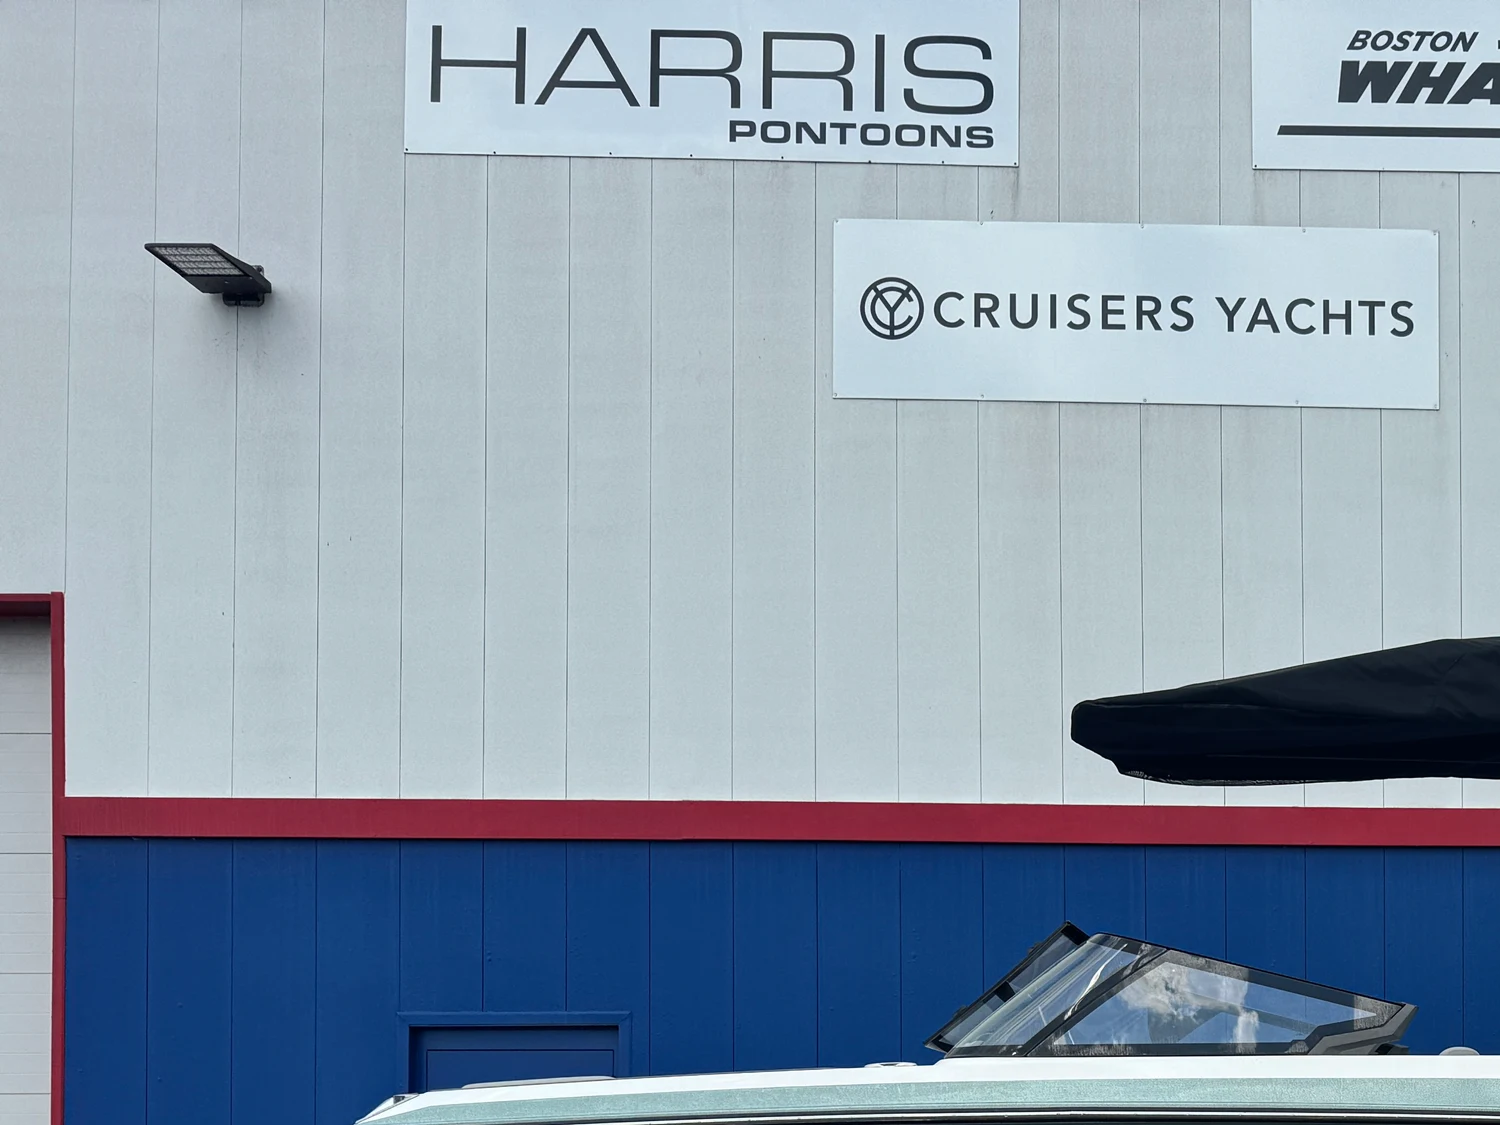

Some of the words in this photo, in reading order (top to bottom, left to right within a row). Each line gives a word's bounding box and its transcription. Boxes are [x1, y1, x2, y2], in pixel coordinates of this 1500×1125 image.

[1346, 29, 1479, 53] BOSTON
[430, 25, 995, 115] HARRIS
[729, 119, 994, 149] PONTOONS
[933, 291, 1194, 332] CRUISERS
[1215, 296, 1414, 338] YACHTS
